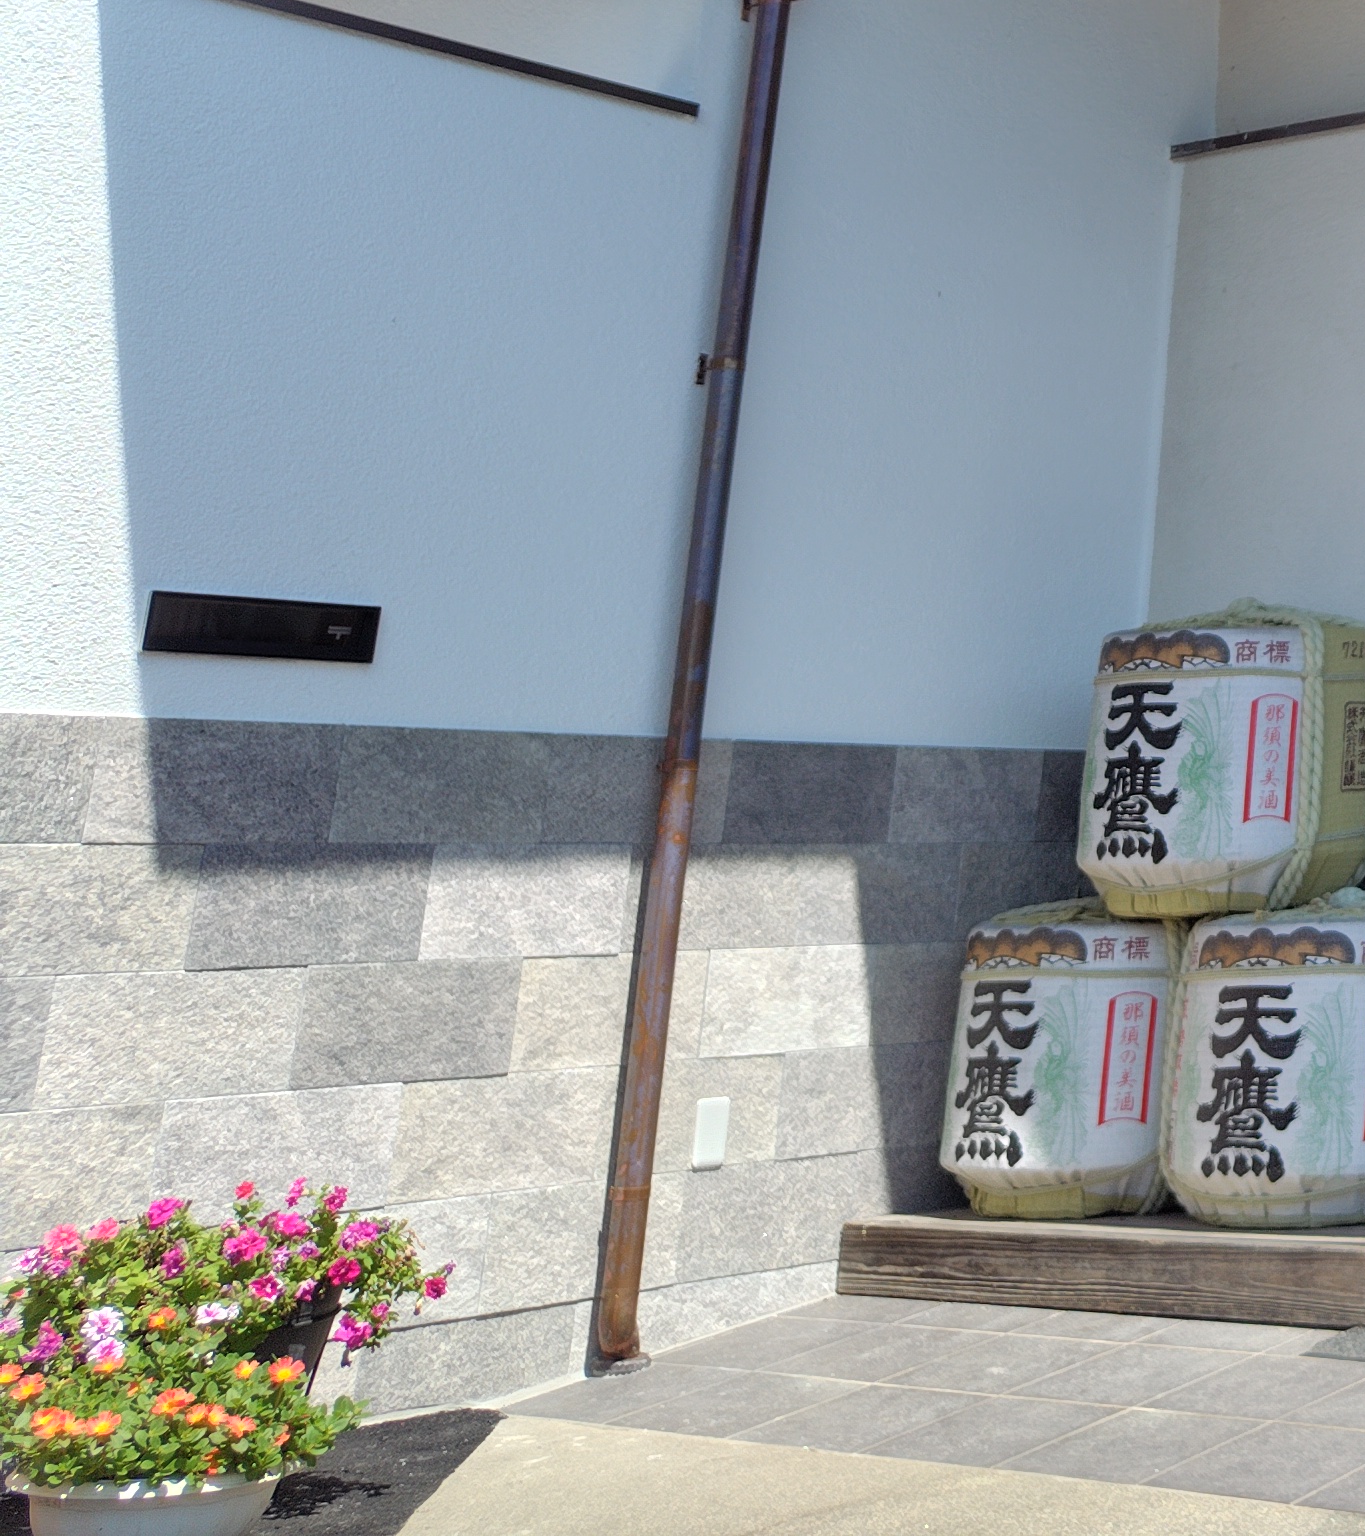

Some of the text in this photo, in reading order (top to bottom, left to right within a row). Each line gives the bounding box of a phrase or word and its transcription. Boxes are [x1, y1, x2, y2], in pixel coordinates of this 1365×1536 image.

[1234, 639, 1292, 664] 商標
[1094, 681, 1184, 864] 天鷹
[1258, 703, 1286, 810] 那須の美酒
[1092, 936, 1151, 962] 商標
[955, 980, 1037, 1168] 天鷹
[1112, 1003, 1144, 1114] 那須の美酒
[1198, 985, 1302, 1182] 天鷹
